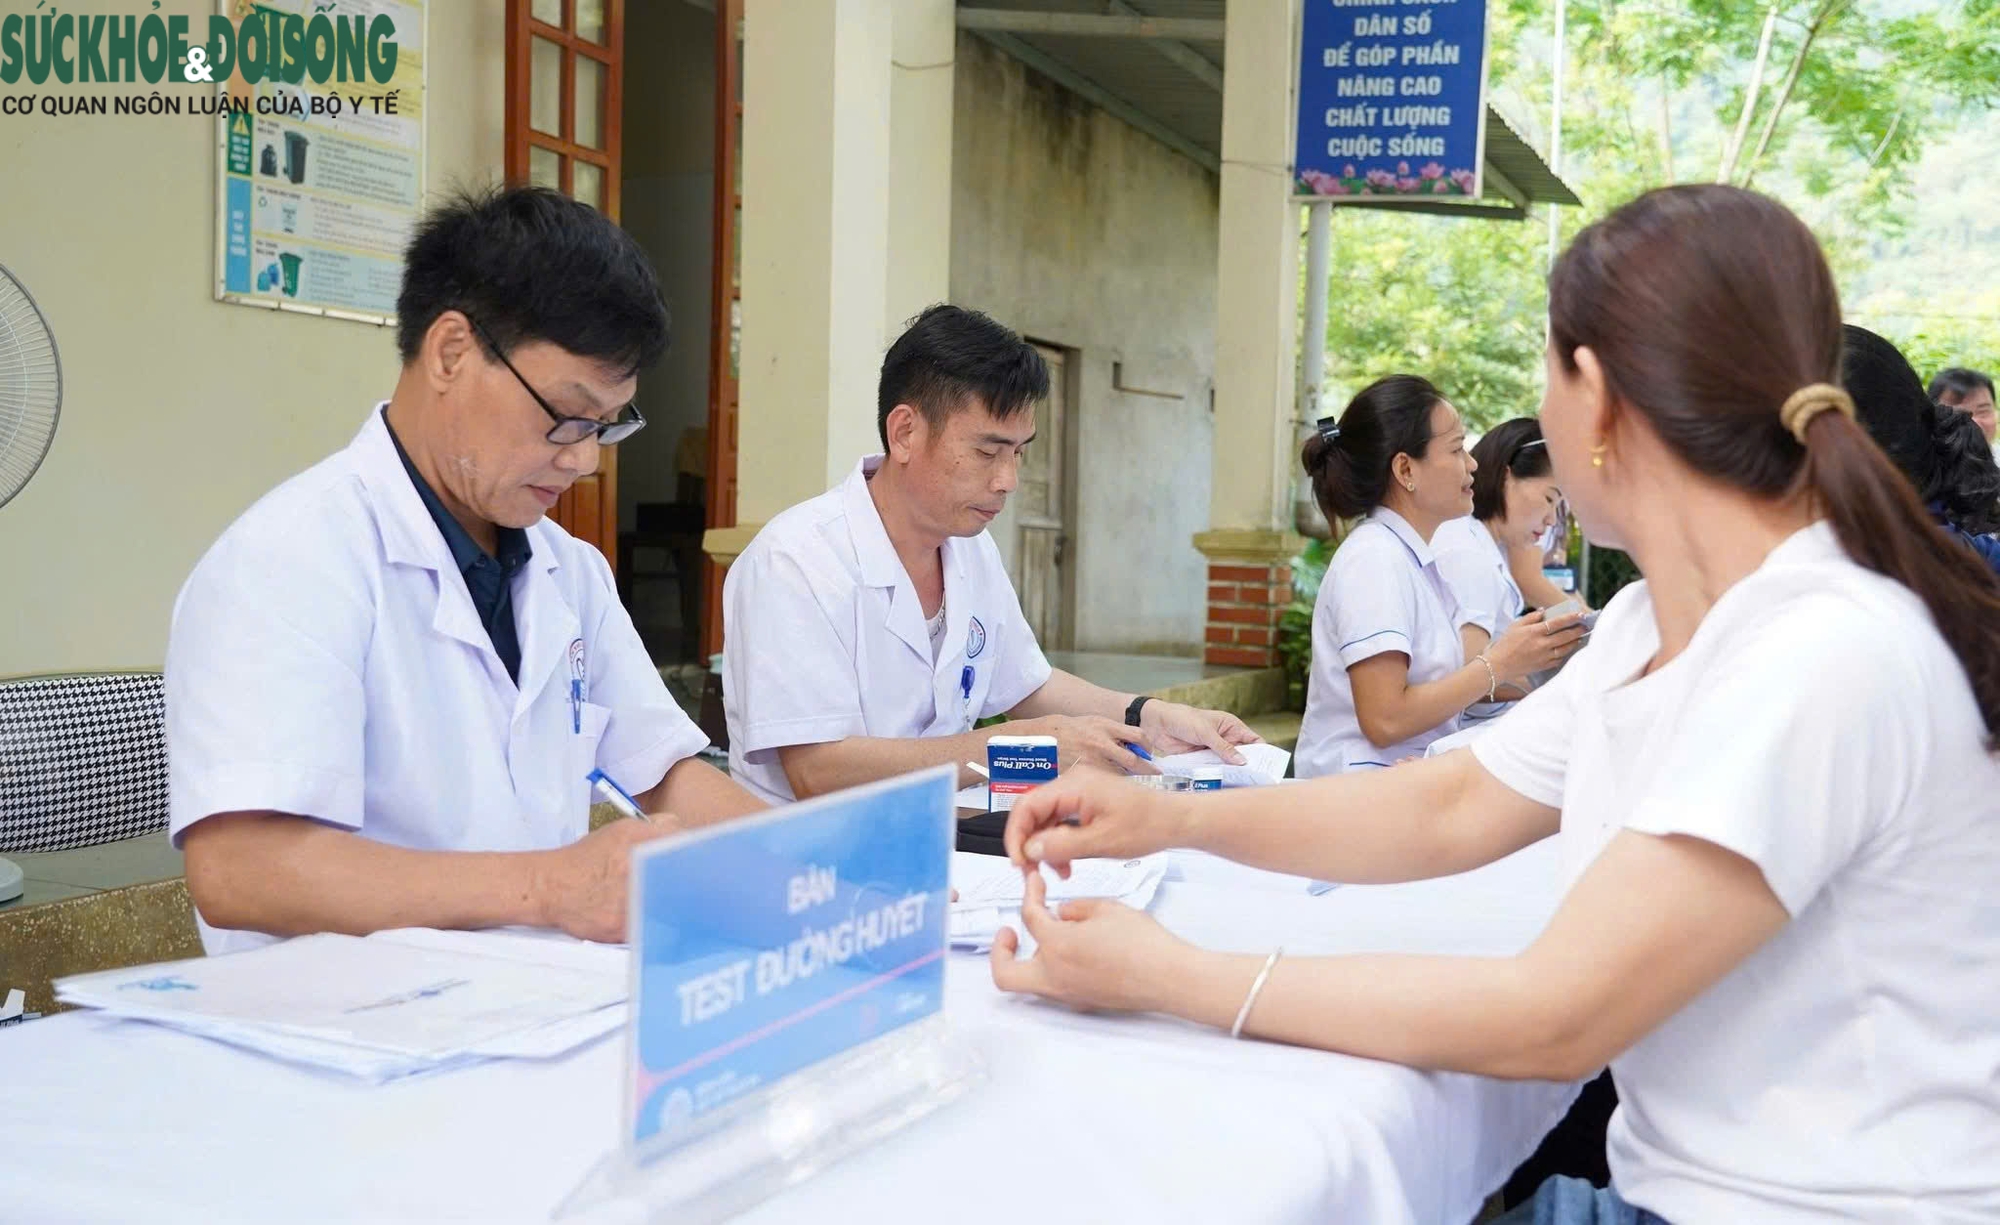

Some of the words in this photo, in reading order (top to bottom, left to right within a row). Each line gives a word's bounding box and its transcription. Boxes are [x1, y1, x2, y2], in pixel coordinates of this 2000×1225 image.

[1354, 13, 1398, 36] DÂN
[1402, 9, 1433, 35] SỐ
[1355, 43, 1397, 66] GÓP
[1336, 74, 1395, 97] NÂNG
[1400, 76, 1442, 96] CAO
[1325, 102, 1379, 127] CHẤT
[1382, 105, 1451, 130] LƯỢNG
[1327, 134, 1383, 161] CUỘC
[1387, 131, 1445, 157] SỐNG
[993, 760, 1013, 769] Plus
[1015, 761, 1035, 770] Call
[1037, 761, 1052, 770] On
[676, 957, 752, 1027] TEST
